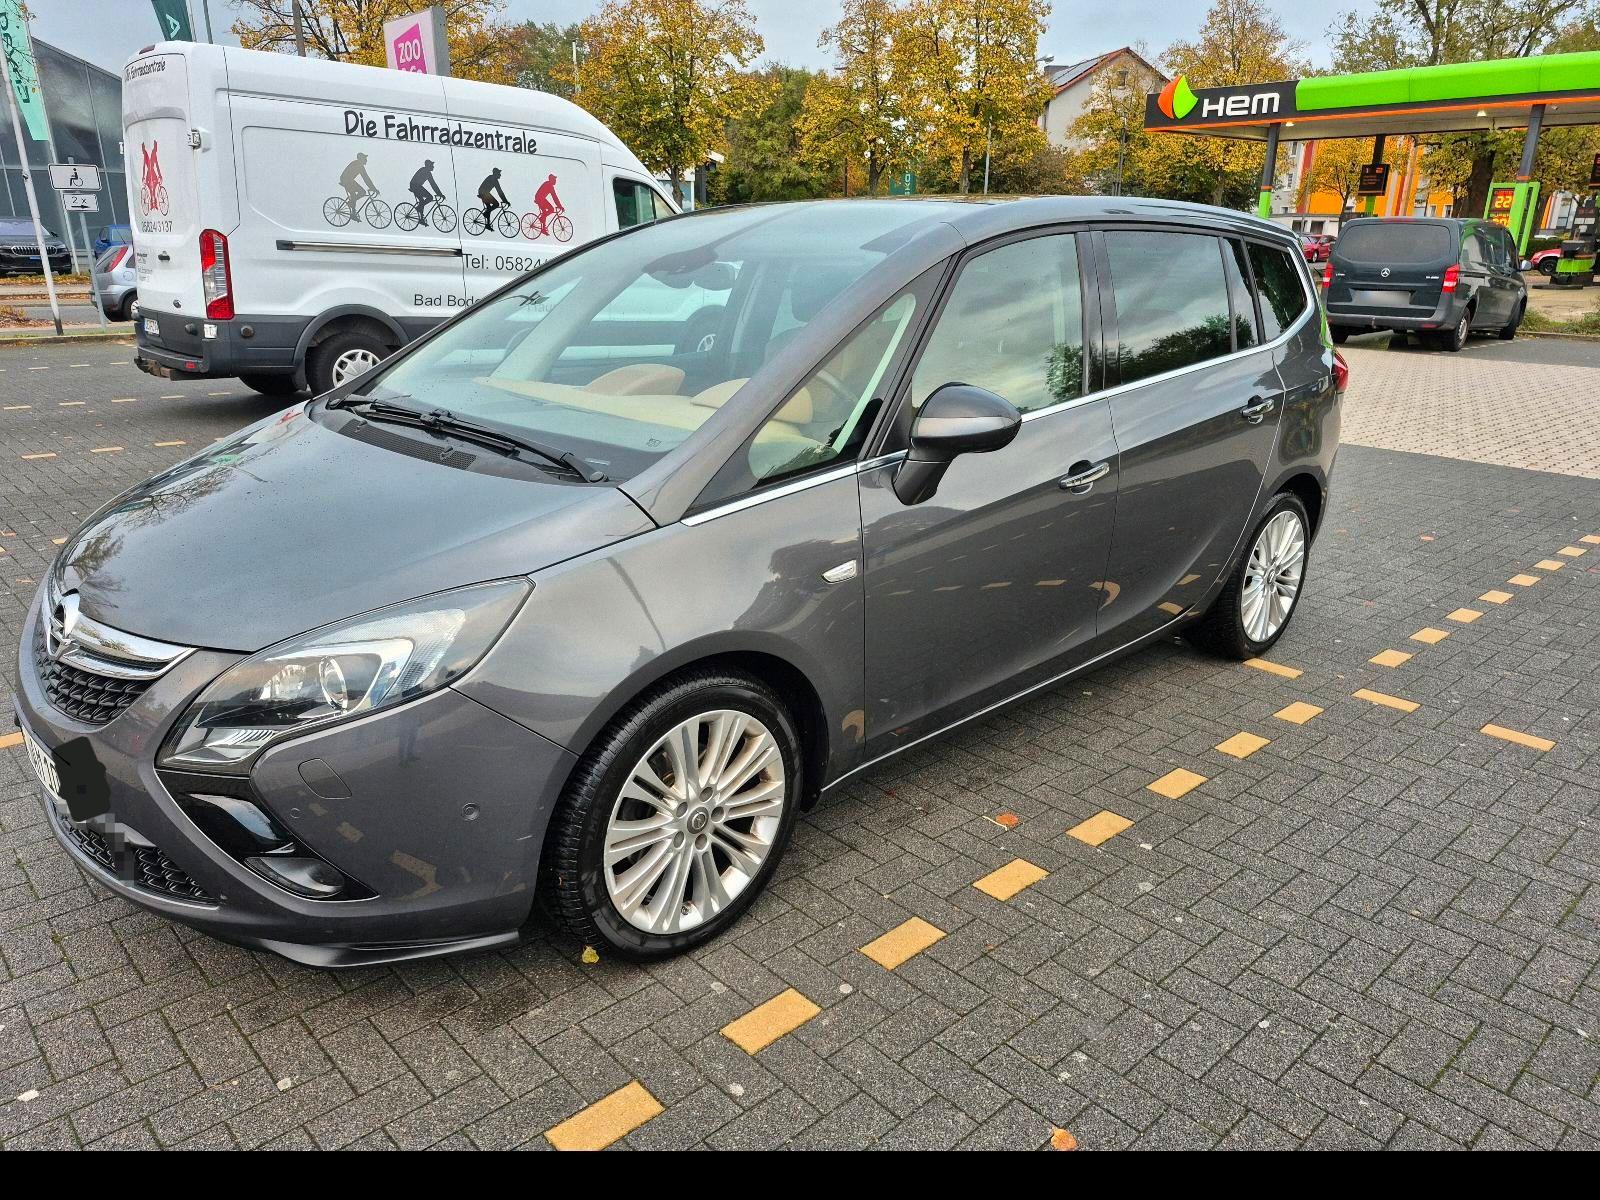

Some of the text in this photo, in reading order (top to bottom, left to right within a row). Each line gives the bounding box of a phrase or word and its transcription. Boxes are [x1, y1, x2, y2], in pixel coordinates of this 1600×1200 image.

[343, 110, 537, 155] Die Fahrradzentrale
[462, 253, 489, 270] Tel:
[414, 294, 442, 307] Bad
